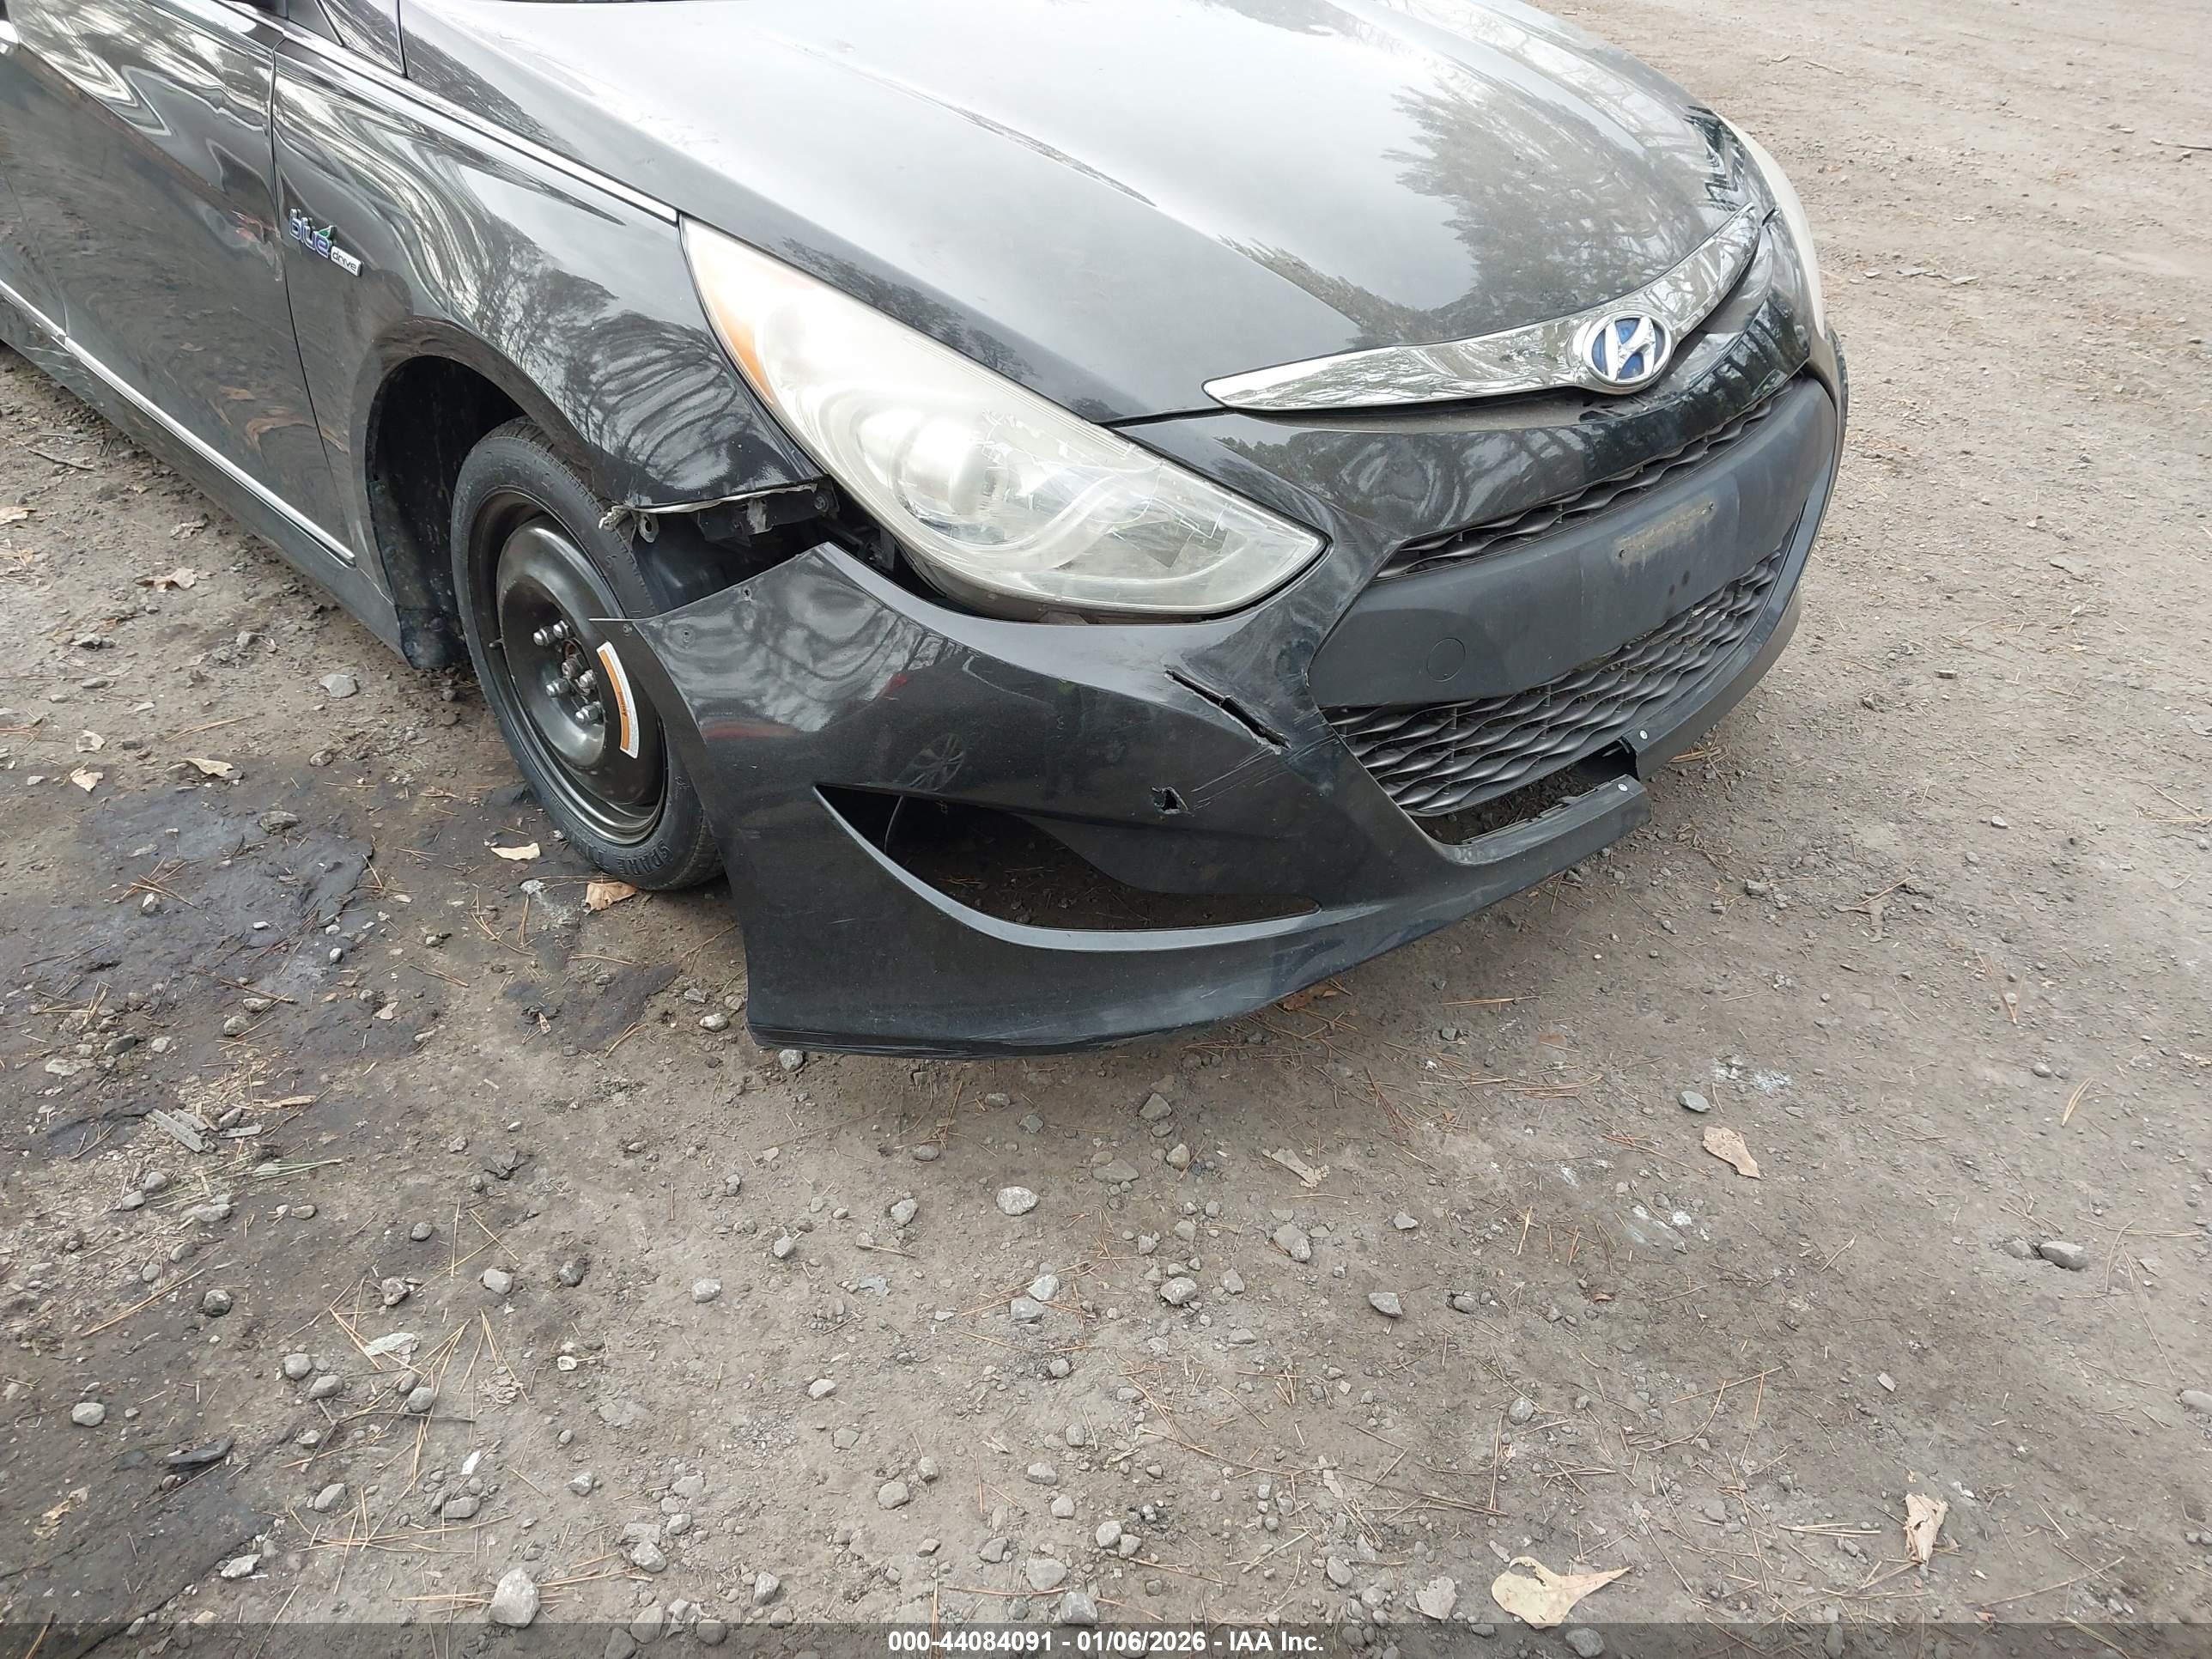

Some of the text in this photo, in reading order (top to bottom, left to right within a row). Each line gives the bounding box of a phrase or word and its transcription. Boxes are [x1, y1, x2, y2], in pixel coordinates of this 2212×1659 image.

[289, 208, 331, 259] blue
[331, 251, 358, 272] drive
[617, 838, 674, 876] SPARE
